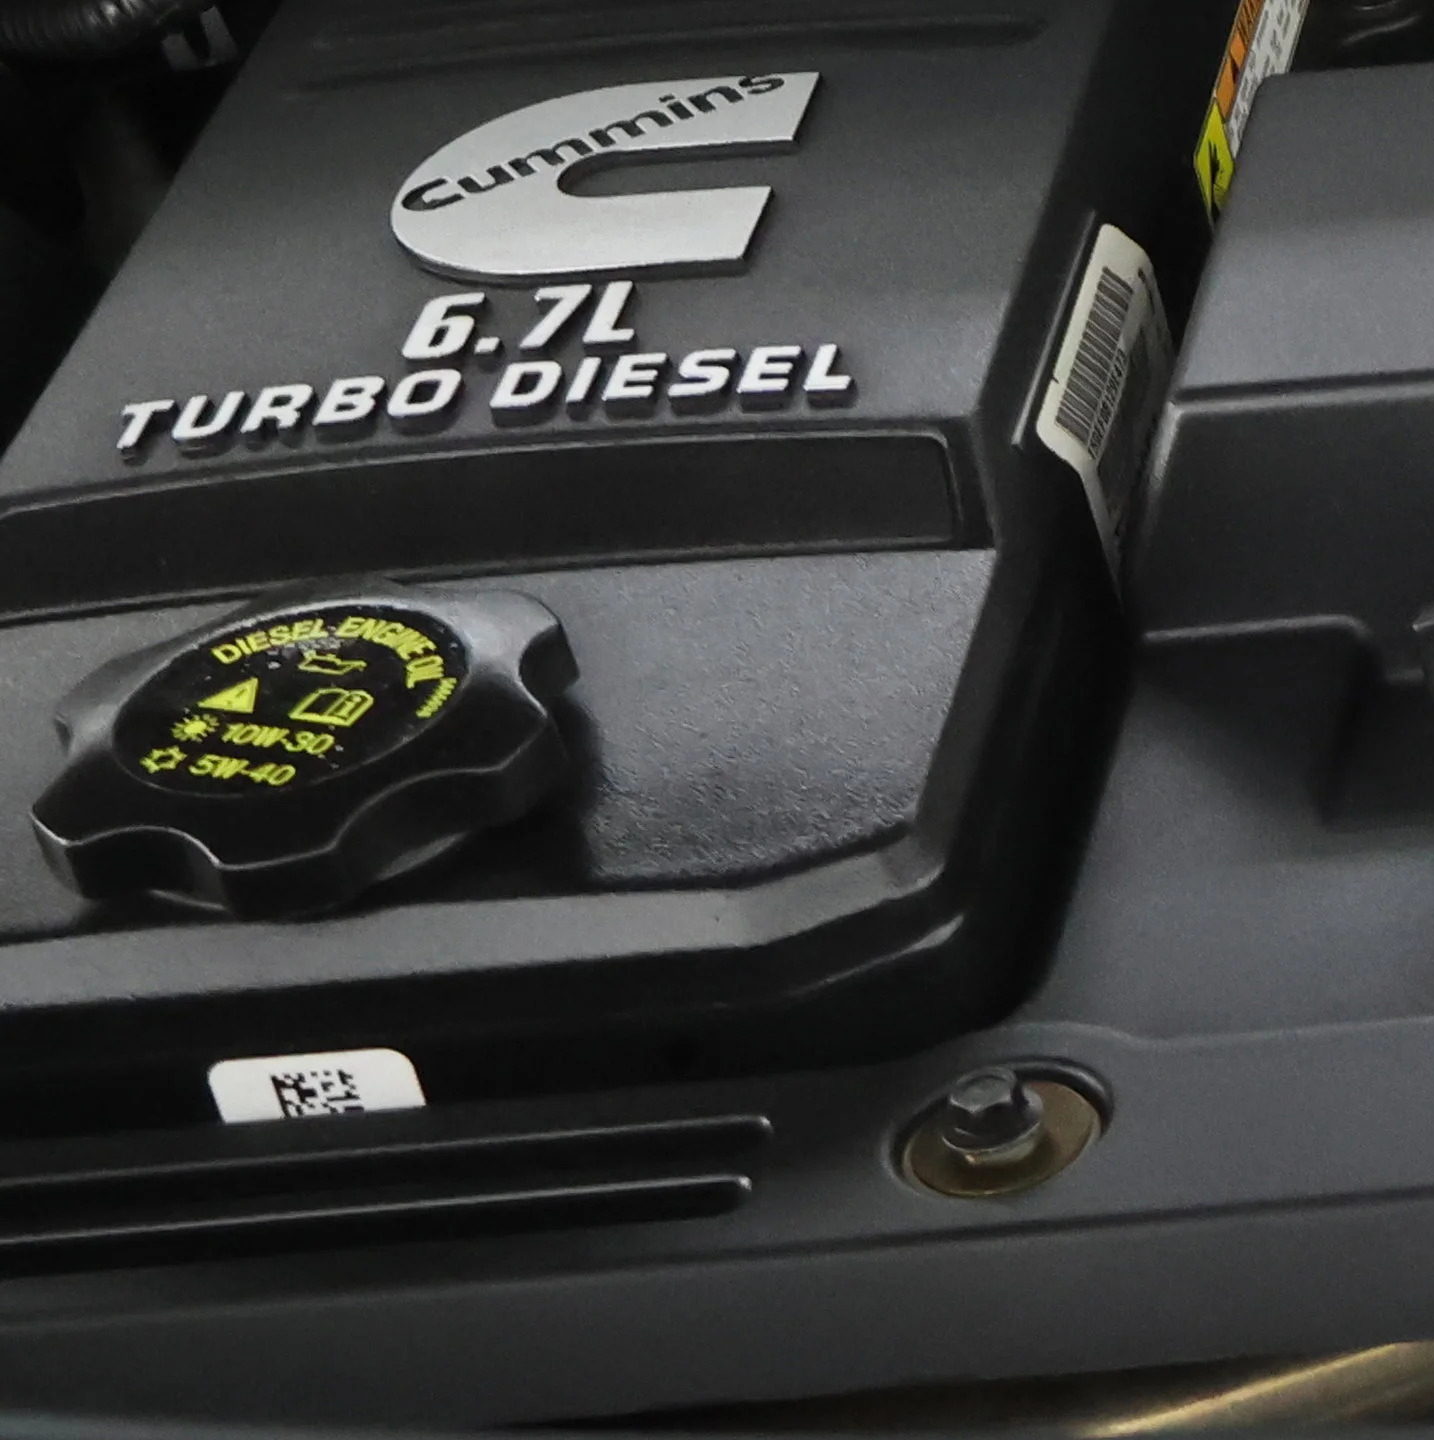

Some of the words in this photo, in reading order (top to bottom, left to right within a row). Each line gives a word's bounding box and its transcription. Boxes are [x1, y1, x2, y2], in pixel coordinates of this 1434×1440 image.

[402, 282, 636, 360] 6.7L
[117, 368, 468, 450] TURBO
[489, 344, 855, 410] DIESEL
[211, 618, 329, 665] DIESEL
[334, 615, 437, 661] ENGINE
[406, 654, 444, 689] OIL
[188, 753, 297, 787] 5W-40
[221, 722, 335, 756] 10W-30
